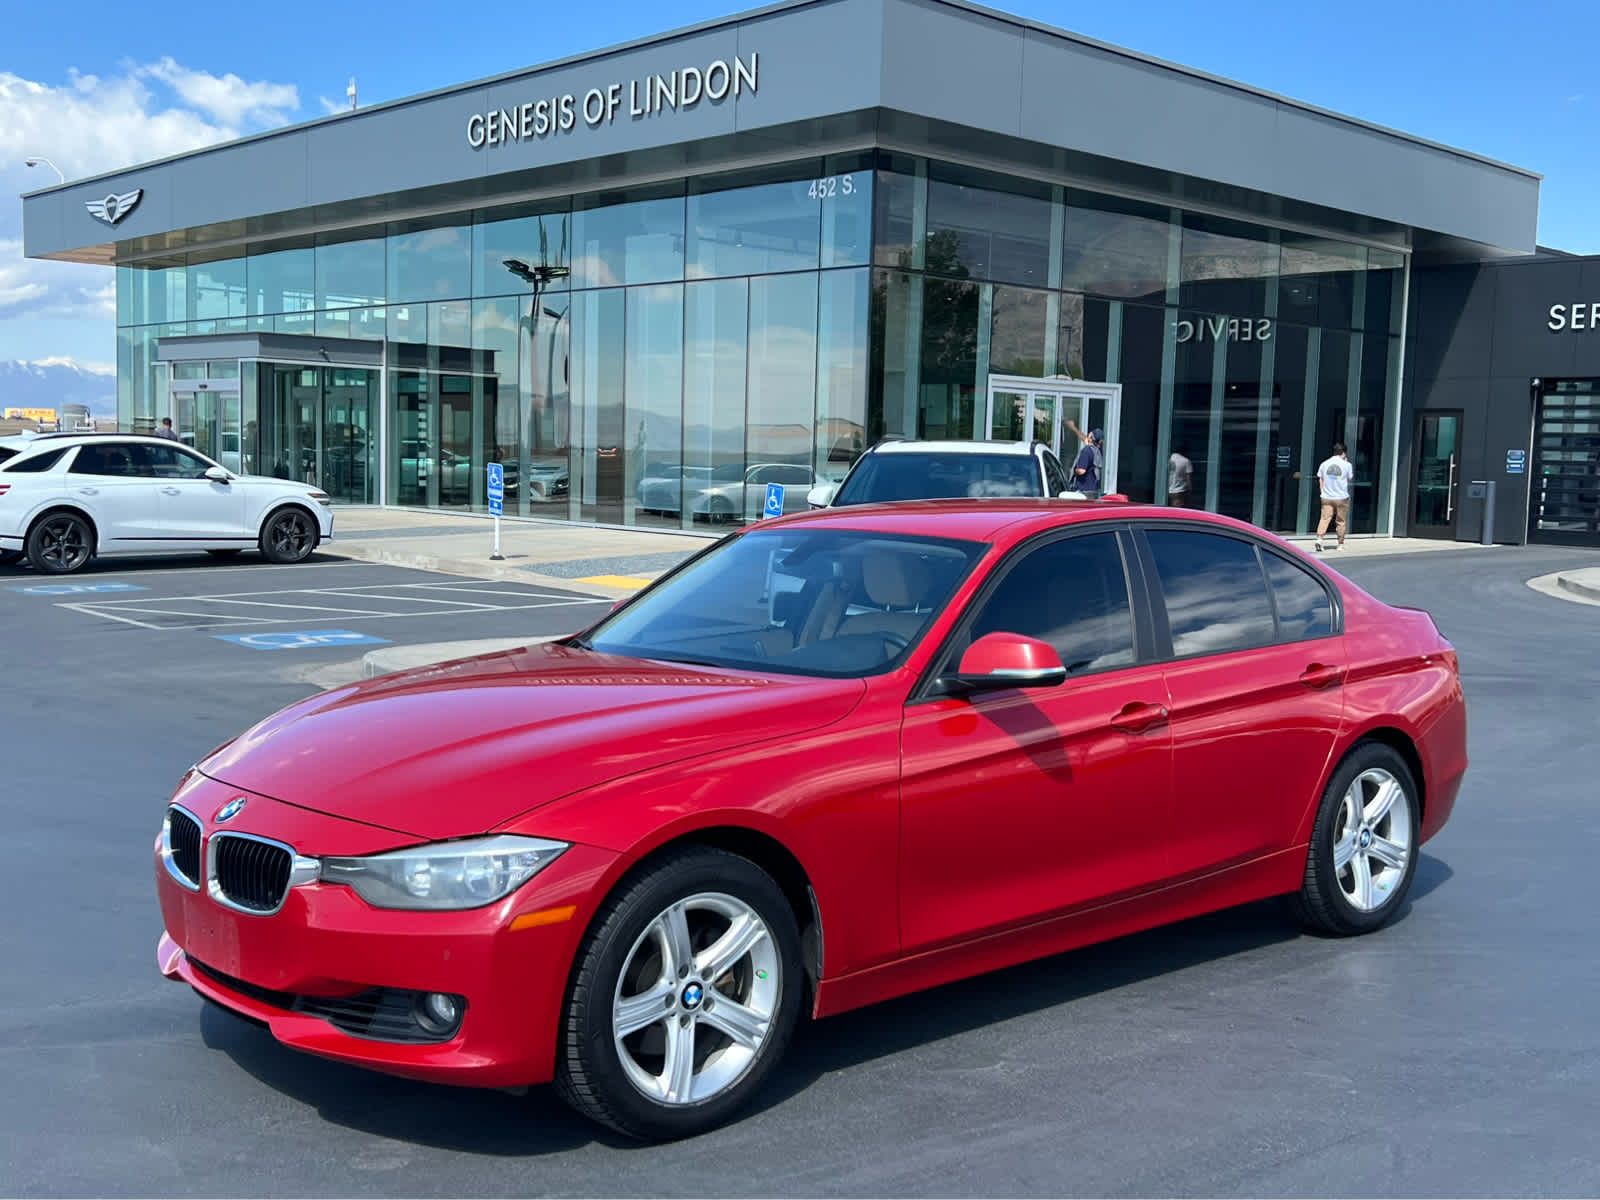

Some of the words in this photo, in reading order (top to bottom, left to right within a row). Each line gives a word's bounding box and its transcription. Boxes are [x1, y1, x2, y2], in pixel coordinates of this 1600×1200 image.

[467, 93, 575, 147] GENESIS
[582, 83, 622, 124] OF
[629, 52, 759, 116] LINDON
[808, 178, 836, 199] 452
[842, 174, 857, 195] S.
